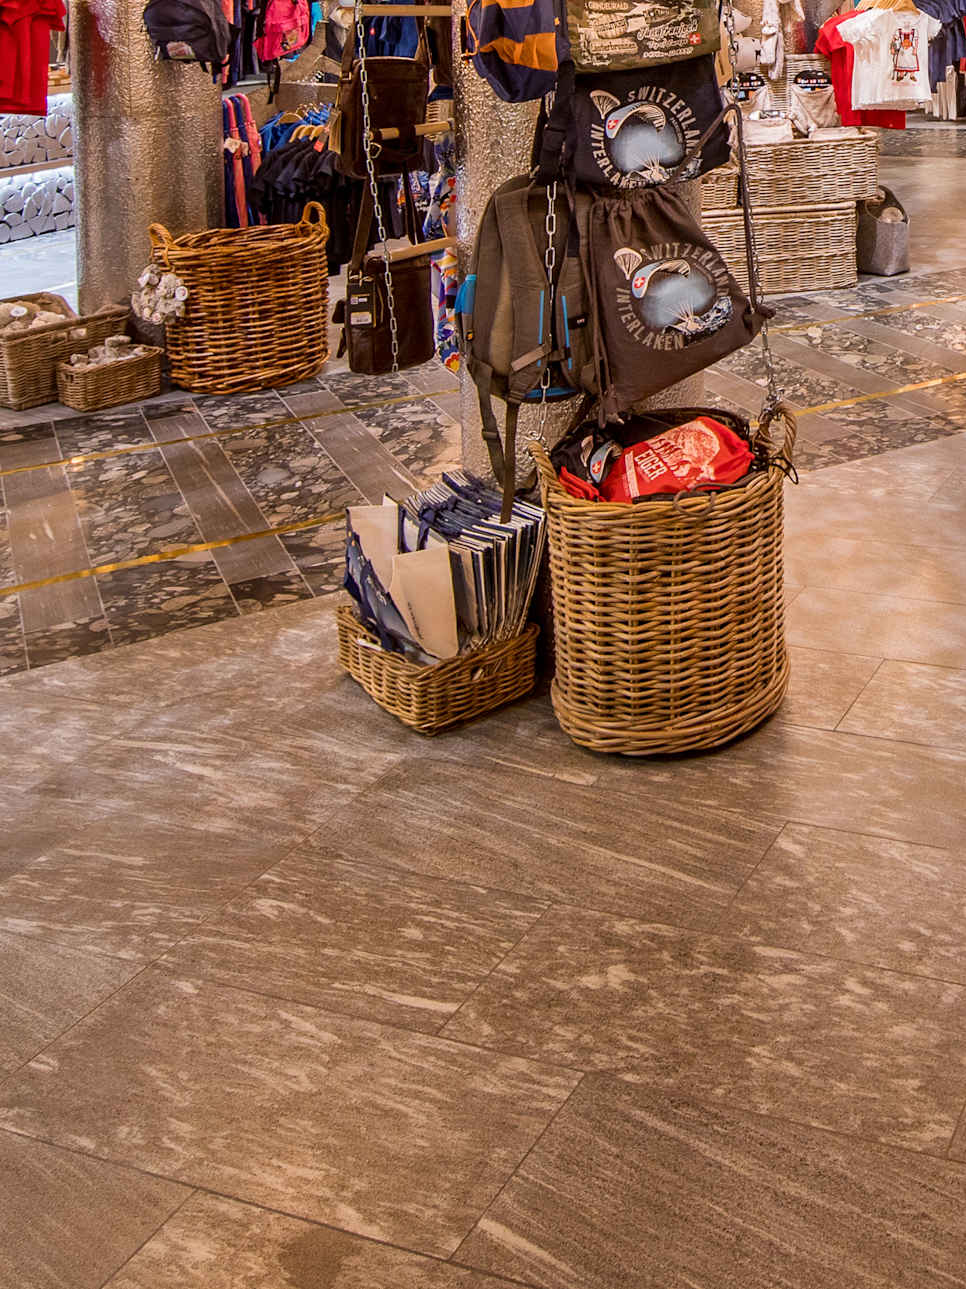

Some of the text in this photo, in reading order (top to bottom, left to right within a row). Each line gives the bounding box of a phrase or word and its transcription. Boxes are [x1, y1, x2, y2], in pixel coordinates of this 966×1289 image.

[640, 242, 730, 297] SWITZERLAND
[616, 287, 685, 351] INTERLAKEN
[634, 449, 668, 480] EIGER
